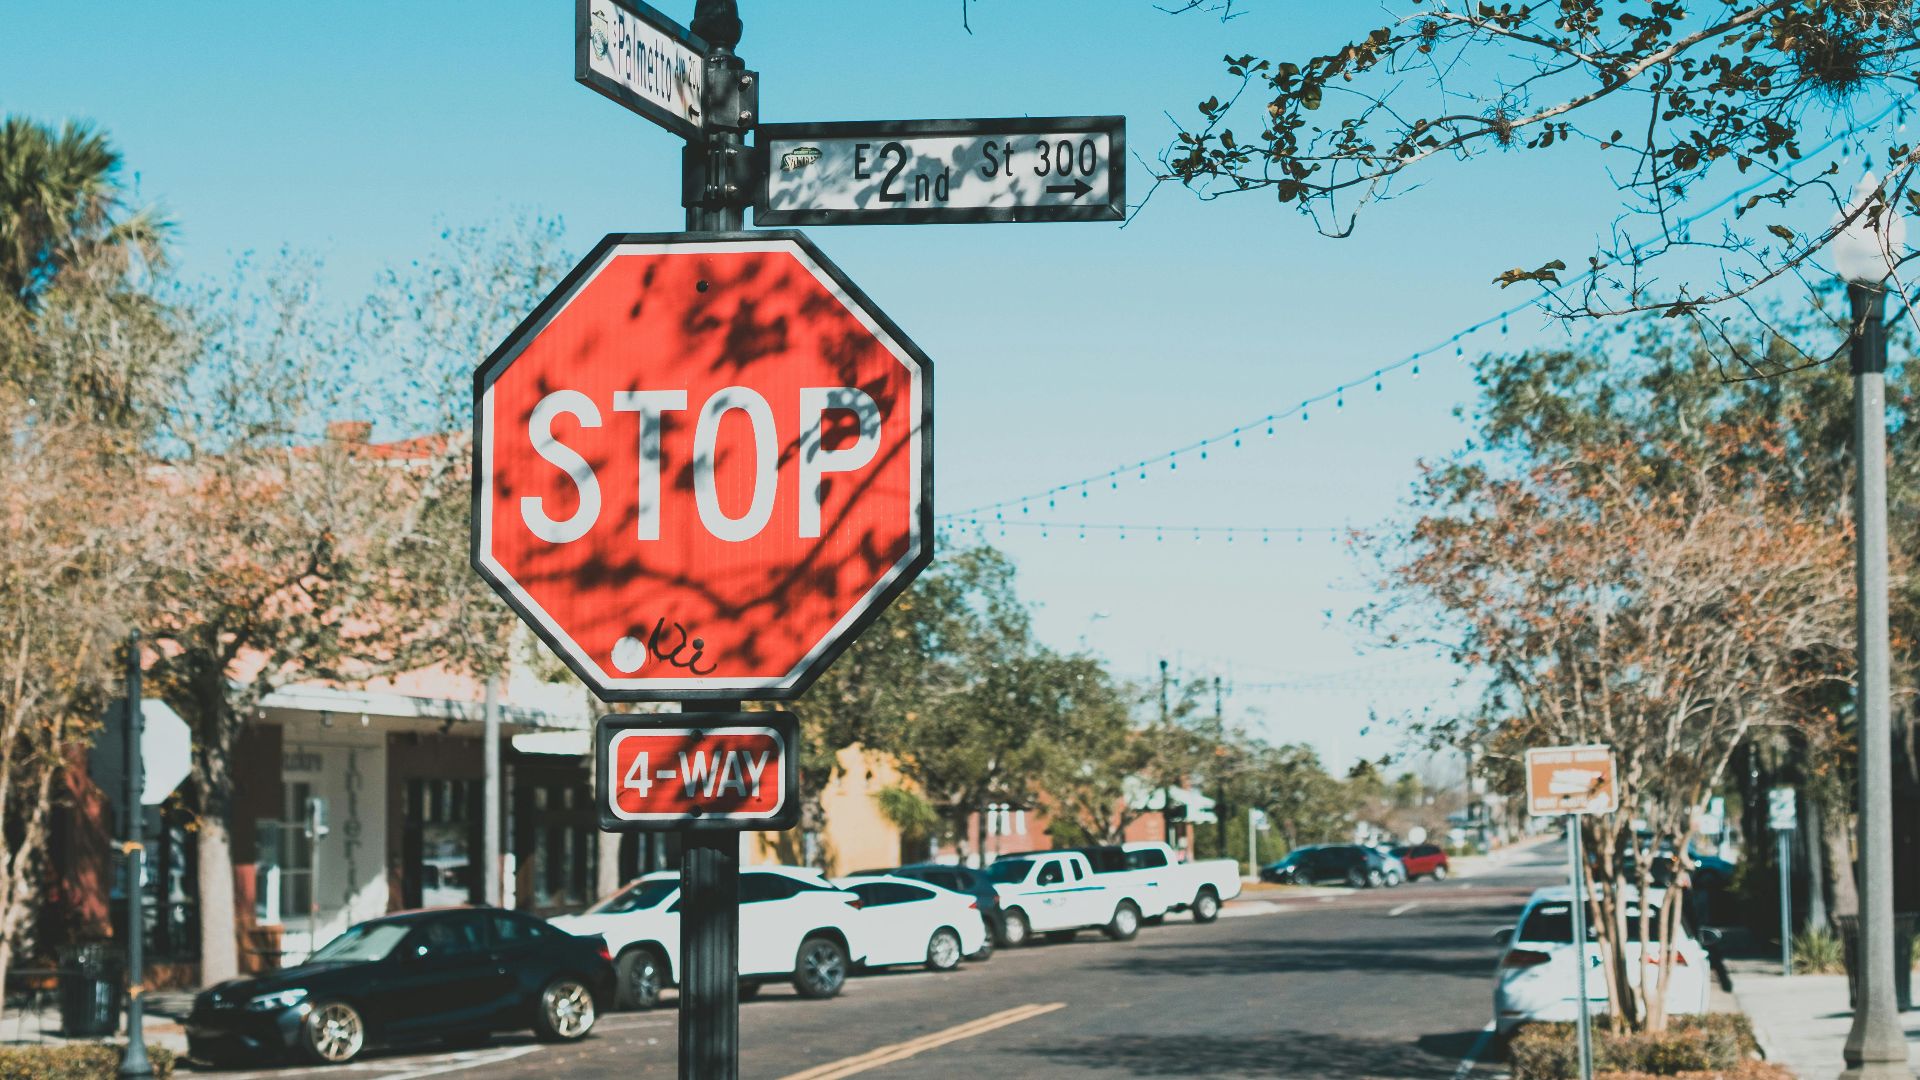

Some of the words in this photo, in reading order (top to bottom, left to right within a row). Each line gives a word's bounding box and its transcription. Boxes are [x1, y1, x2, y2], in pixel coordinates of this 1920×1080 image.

[618, 14, 672, 102] Palmetto
[854, 143, 871, 180] E
[879, 141, 949, 203] 2nd
[981, 140, 1014, 178] St
[1033, 139, 1097, 178] 300
[520, 385, 882, 543] STOP
[623, 750, 770, 798] 4-WAY
